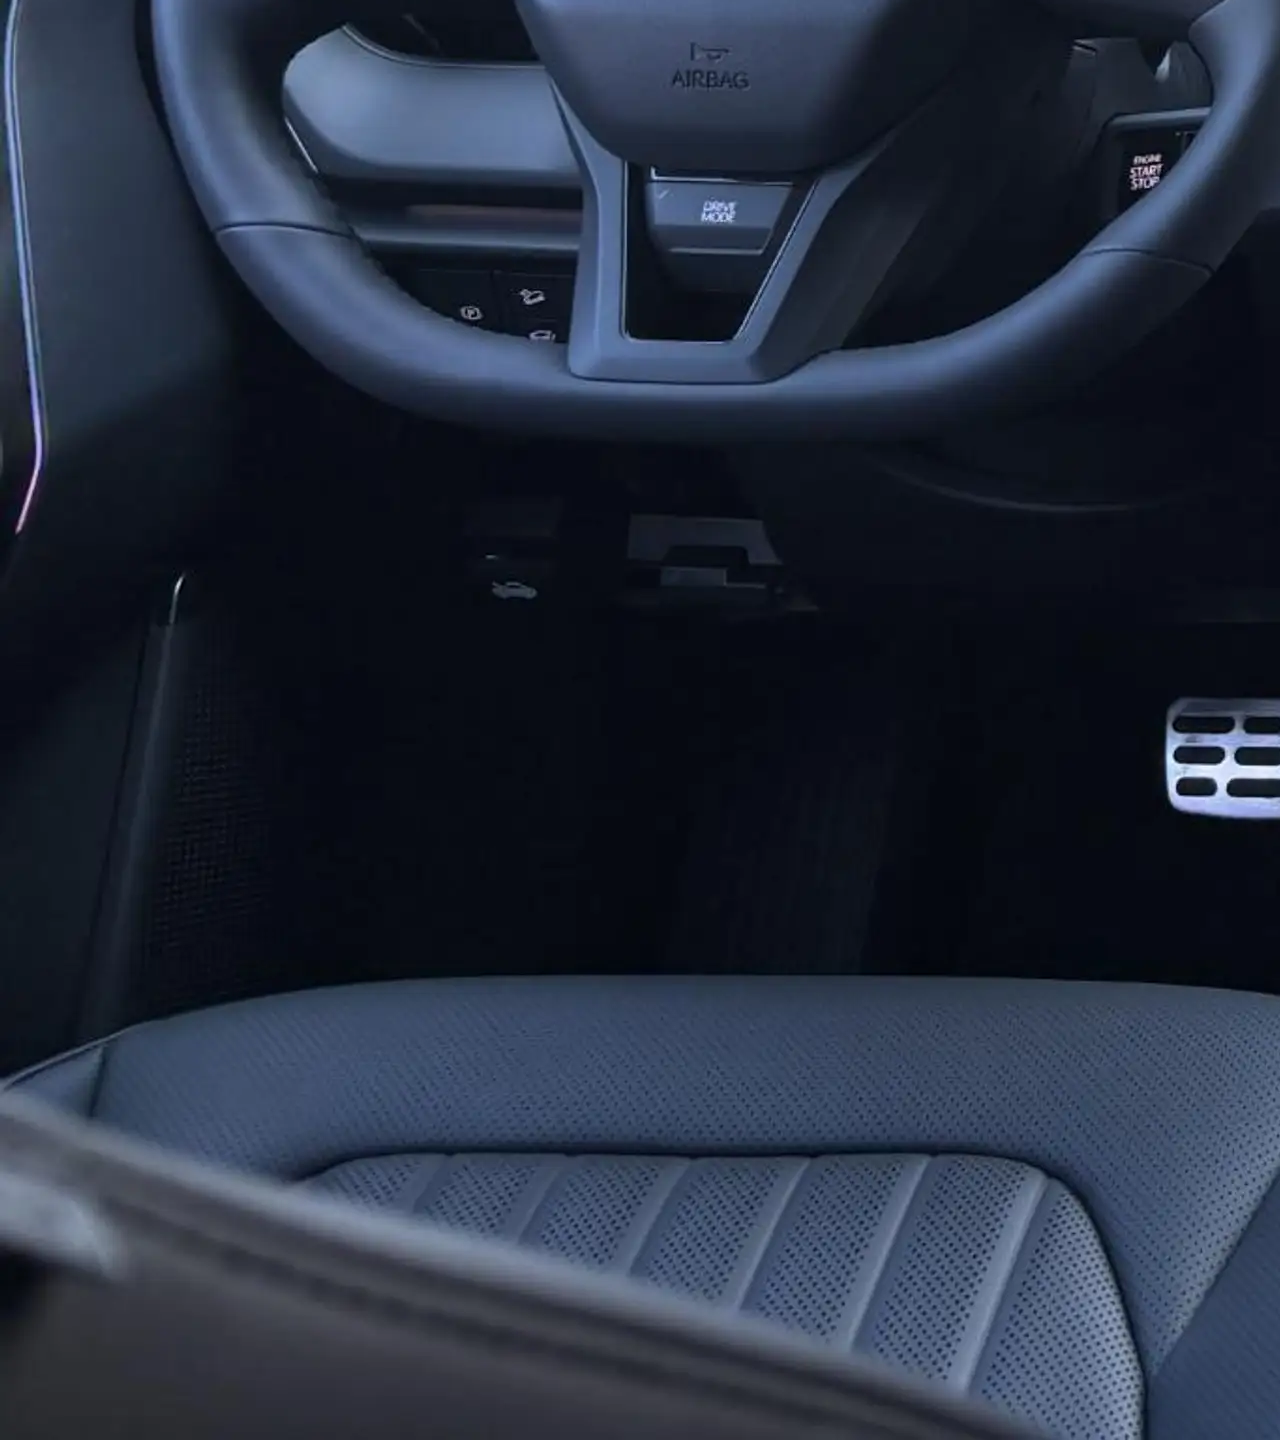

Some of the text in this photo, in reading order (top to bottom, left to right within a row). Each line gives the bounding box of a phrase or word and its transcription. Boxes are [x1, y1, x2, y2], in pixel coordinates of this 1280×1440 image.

[672, 68, 750, 90] AIRBAG
[1129, 163, 1164, 179] START
[1130, 176, 1161, 191] STOP
[700, 211, 736, 223] MODE
